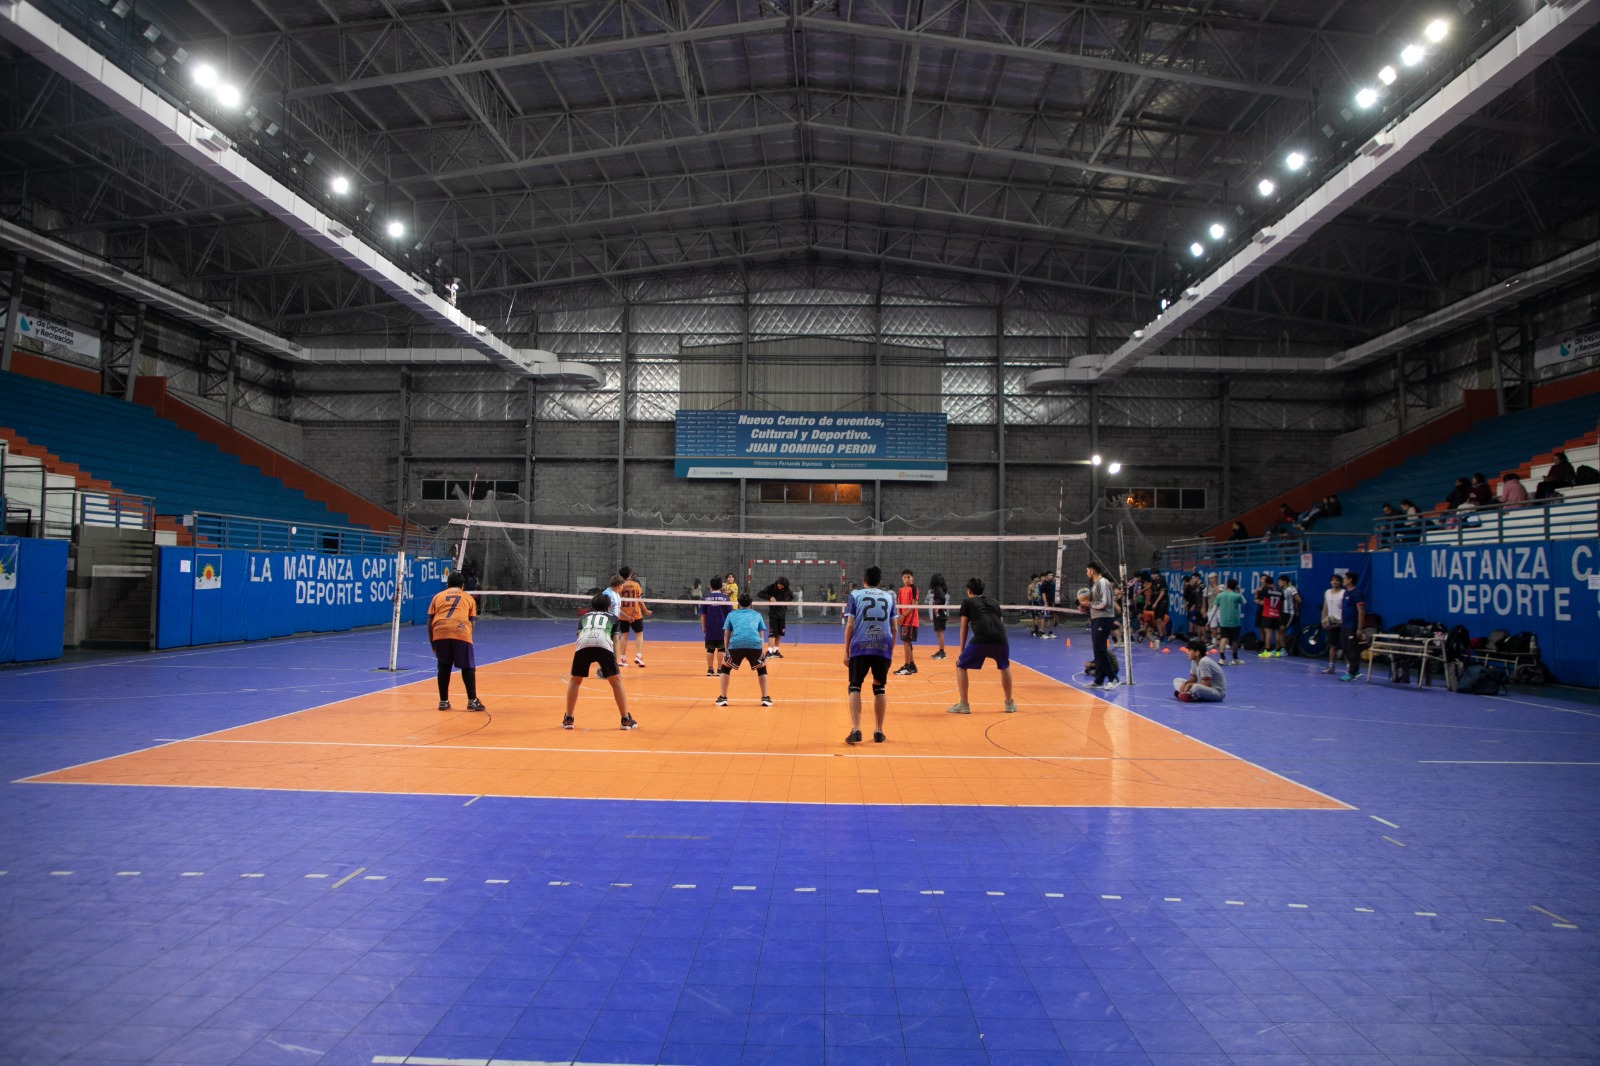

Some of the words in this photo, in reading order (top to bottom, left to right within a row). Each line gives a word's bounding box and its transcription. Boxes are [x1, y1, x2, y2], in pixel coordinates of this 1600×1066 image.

[36, 319, 46, 328] de
[46, 322, 74, 338] Deportes
[40, 329, 74, 345] Recreación
[738, 414, 774, 425] Nuevo
[777, 415, 816, 426] Centro
[818, 416, 833, 426] de
[836, 417, 885, 428] eventos,
[751, 428, 798, 439] Cultural
[800, 431, 808, 441] y
[811, 429, 871, 441] Deportivo.
[745, 443, 777, 453] JUAN
[780, 443, 834, 454] DOMINGO
[837, 444, 877, 454] PERON
[250, 556, 272, 582] LA
[284, 554, 354, 581] MATANZA
[421, 561, 440, 582] DEL
[1393, 551, 1417, 578] LA
[1431, 546, 1550, 581] MATANZA
[295, 580, 363, 605] DEPORTE
[369, 580, 414, 602] SOCAL
[1448, 583, 1572, 621] DEPORTE
[446, 595, 461, 619] 7
[862, 596, 888, 622] 23
[1269, 596, 1281, 609] 17
[583, 614, 609, 629] 10
